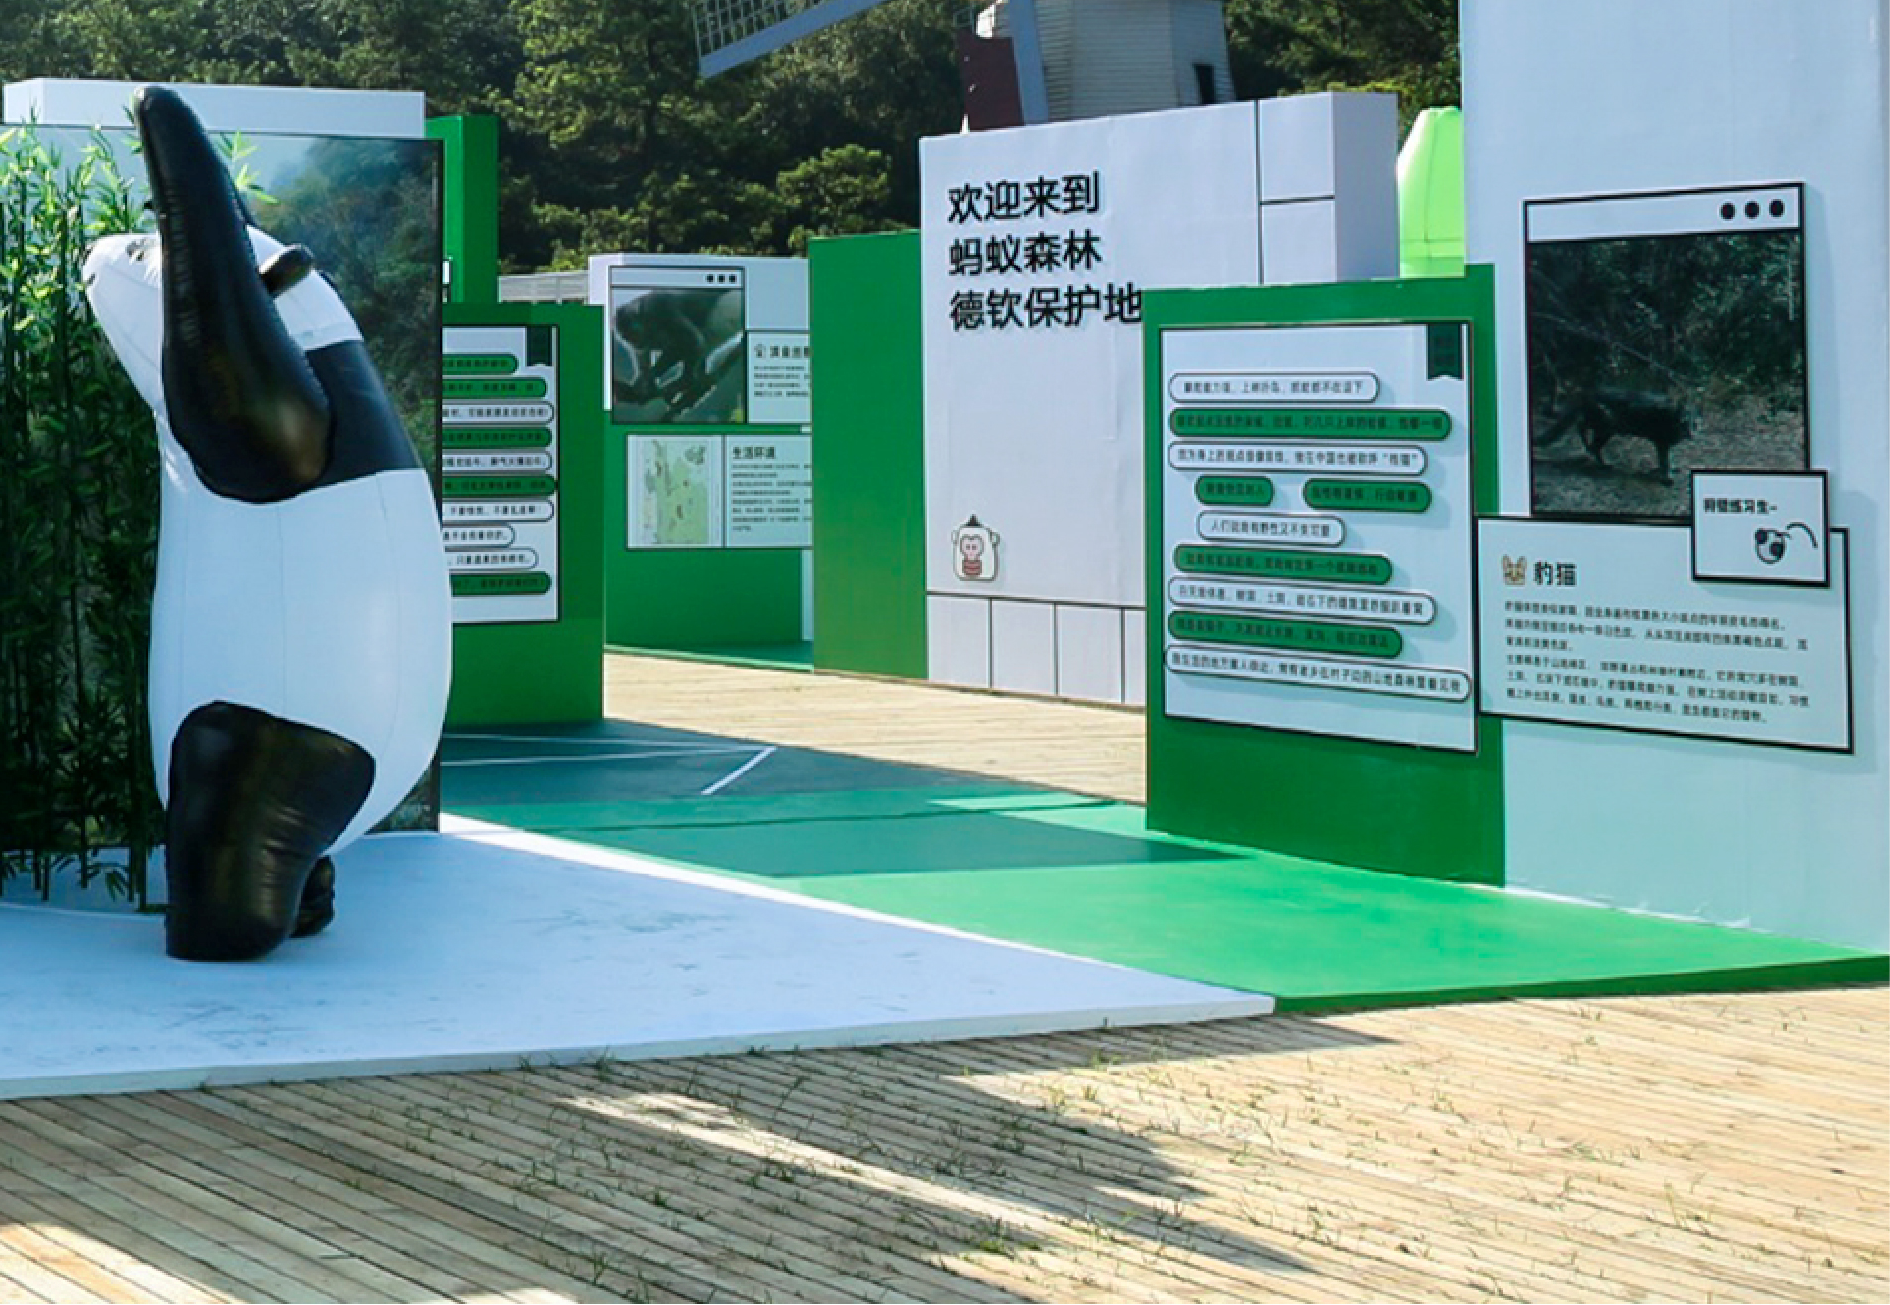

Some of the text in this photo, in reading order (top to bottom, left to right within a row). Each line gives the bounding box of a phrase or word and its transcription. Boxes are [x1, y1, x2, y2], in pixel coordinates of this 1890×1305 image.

[947, 171, 1100, 225] 欢迎来到
[948, 228, 1103, 277] 蚂蚁森林
[950, 282, 1142, 333] 德钦保护地
[1533, 560, 1578, 586] 豹猫
